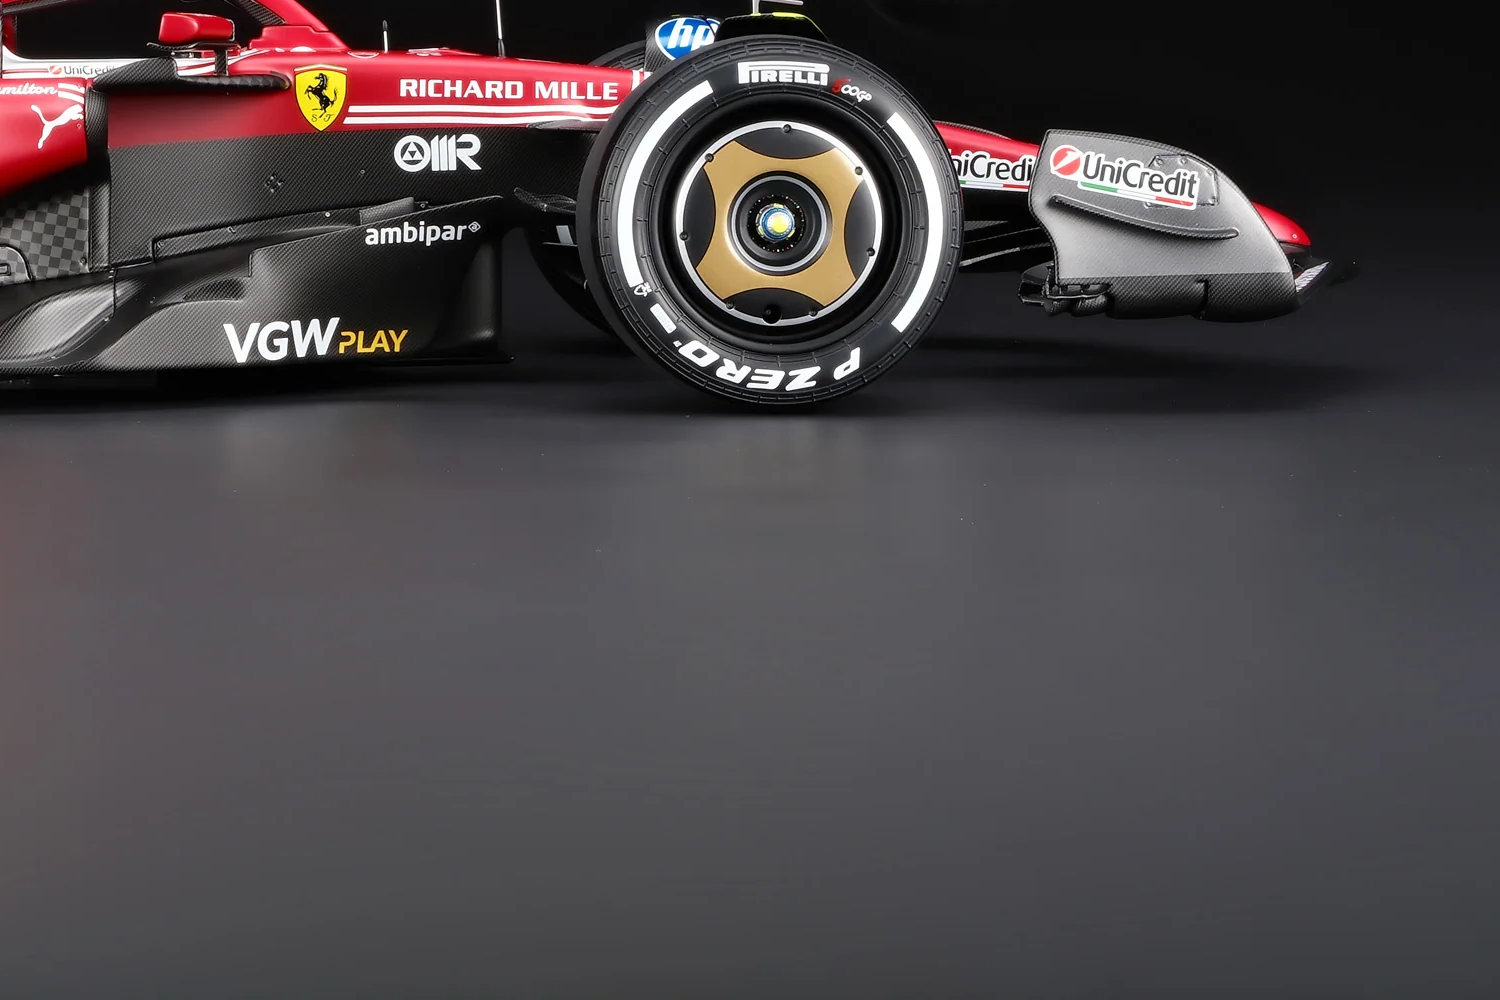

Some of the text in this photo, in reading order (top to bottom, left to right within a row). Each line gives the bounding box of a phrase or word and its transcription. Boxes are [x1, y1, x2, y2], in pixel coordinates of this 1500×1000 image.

[667, 19, 719, 52] hp
[400, 78, 618, 100] RICHARD MILLE
[737, 61, 830, 86] PIRELLI
[951, 153, 1033, 182] niCredi
[1082, 153, 1197, 199] UniCredit
[365, 220, 467, 246] ambipar
[223, 317, 409, 364] VGW PLAY
[677, 339, 861, 392] P ZERO
